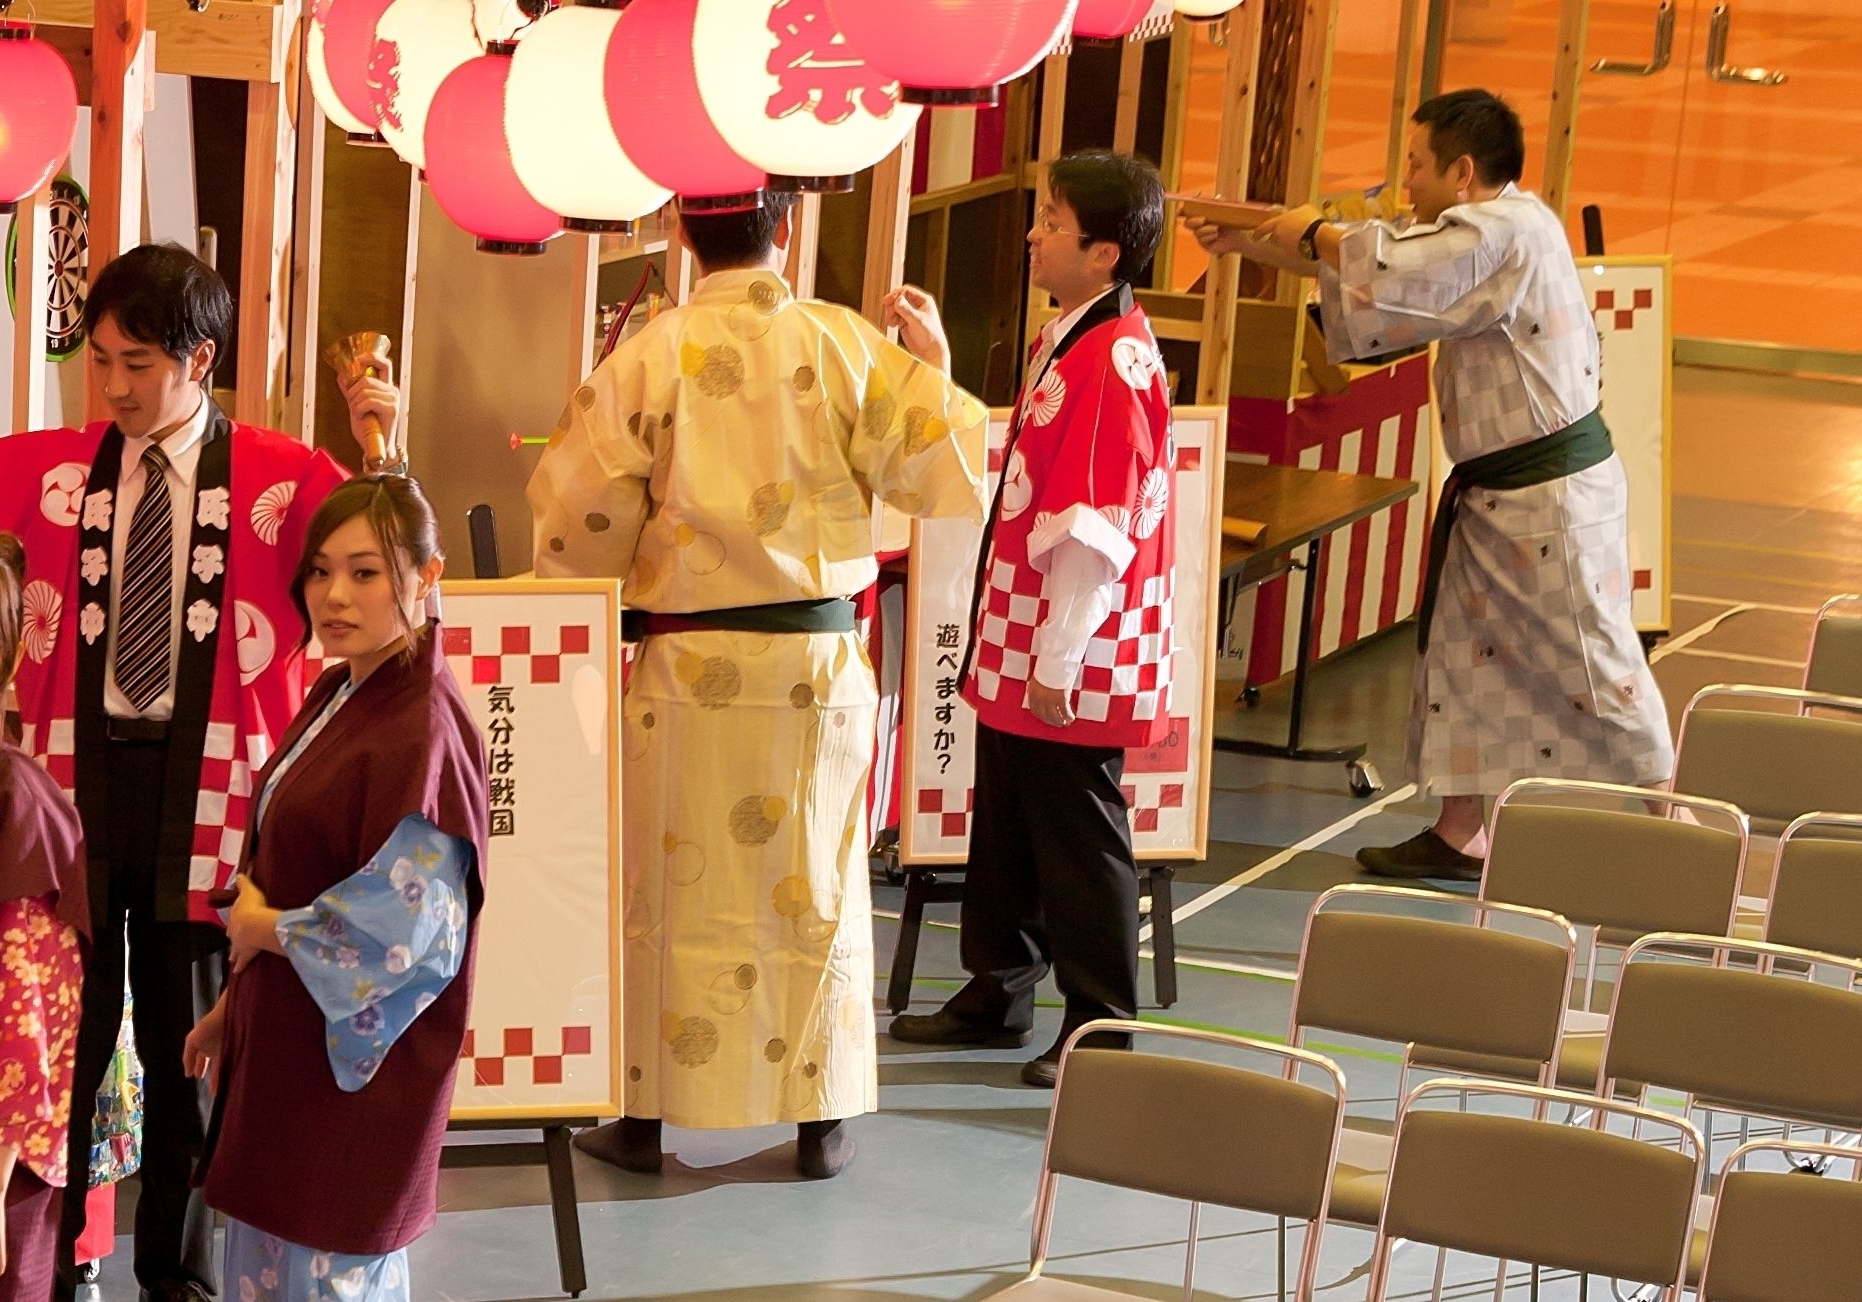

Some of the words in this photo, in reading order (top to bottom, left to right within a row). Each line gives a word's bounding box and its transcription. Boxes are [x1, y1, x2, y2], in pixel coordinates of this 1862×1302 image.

[487, 685, 515, 837] 気分は戦国
